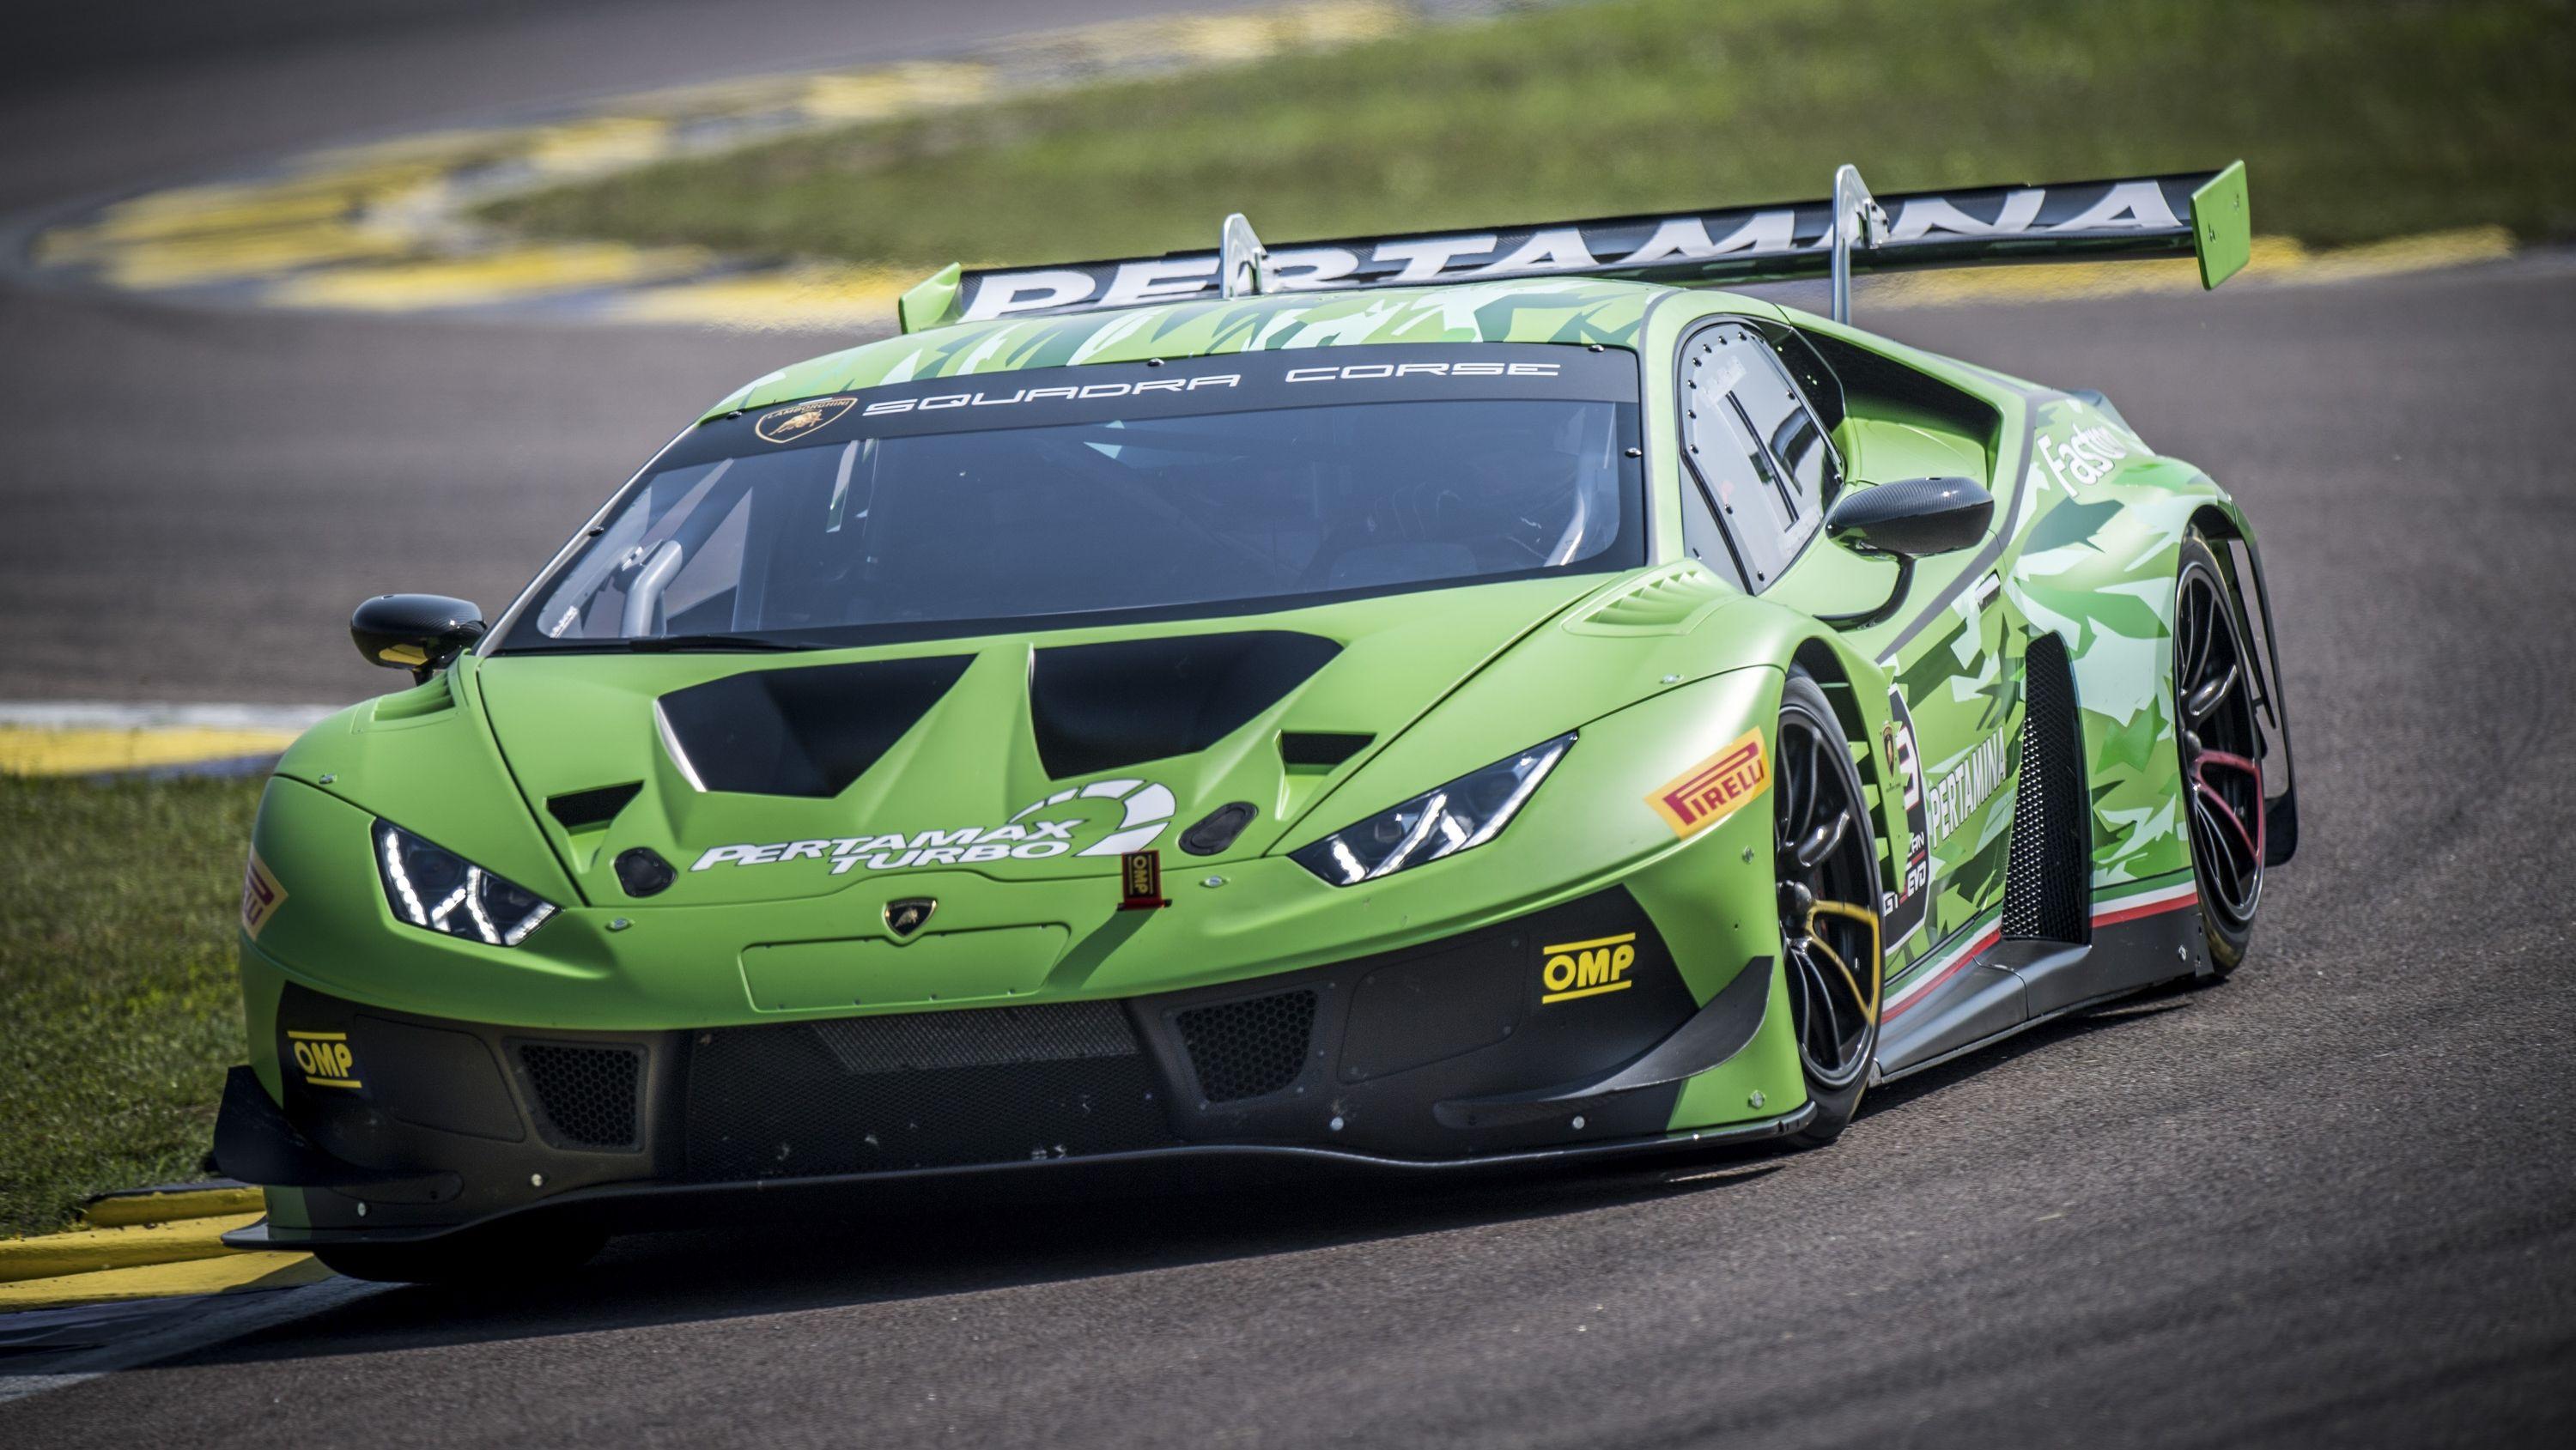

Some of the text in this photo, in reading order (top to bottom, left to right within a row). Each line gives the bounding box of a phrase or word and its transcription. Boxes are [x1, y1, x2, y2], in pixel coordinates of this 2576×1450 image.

[767, 400, 850, 420] LAMBORGHINI
[862, 363, 1561, 416] SQUADRA CORSE
[1662, 741, 1765, 826] PIRELLI
[1929, 725, 2007, 850] PERTAMINA
[688, 818, 1091, 873] PERTAMAX
[829, 840, 1072, 876] TURBO
[1133, 855, 1149, 894] OMP
[1543, 944, 1636, 992] OMP
[293, 1040, 354, 1078] OMP
